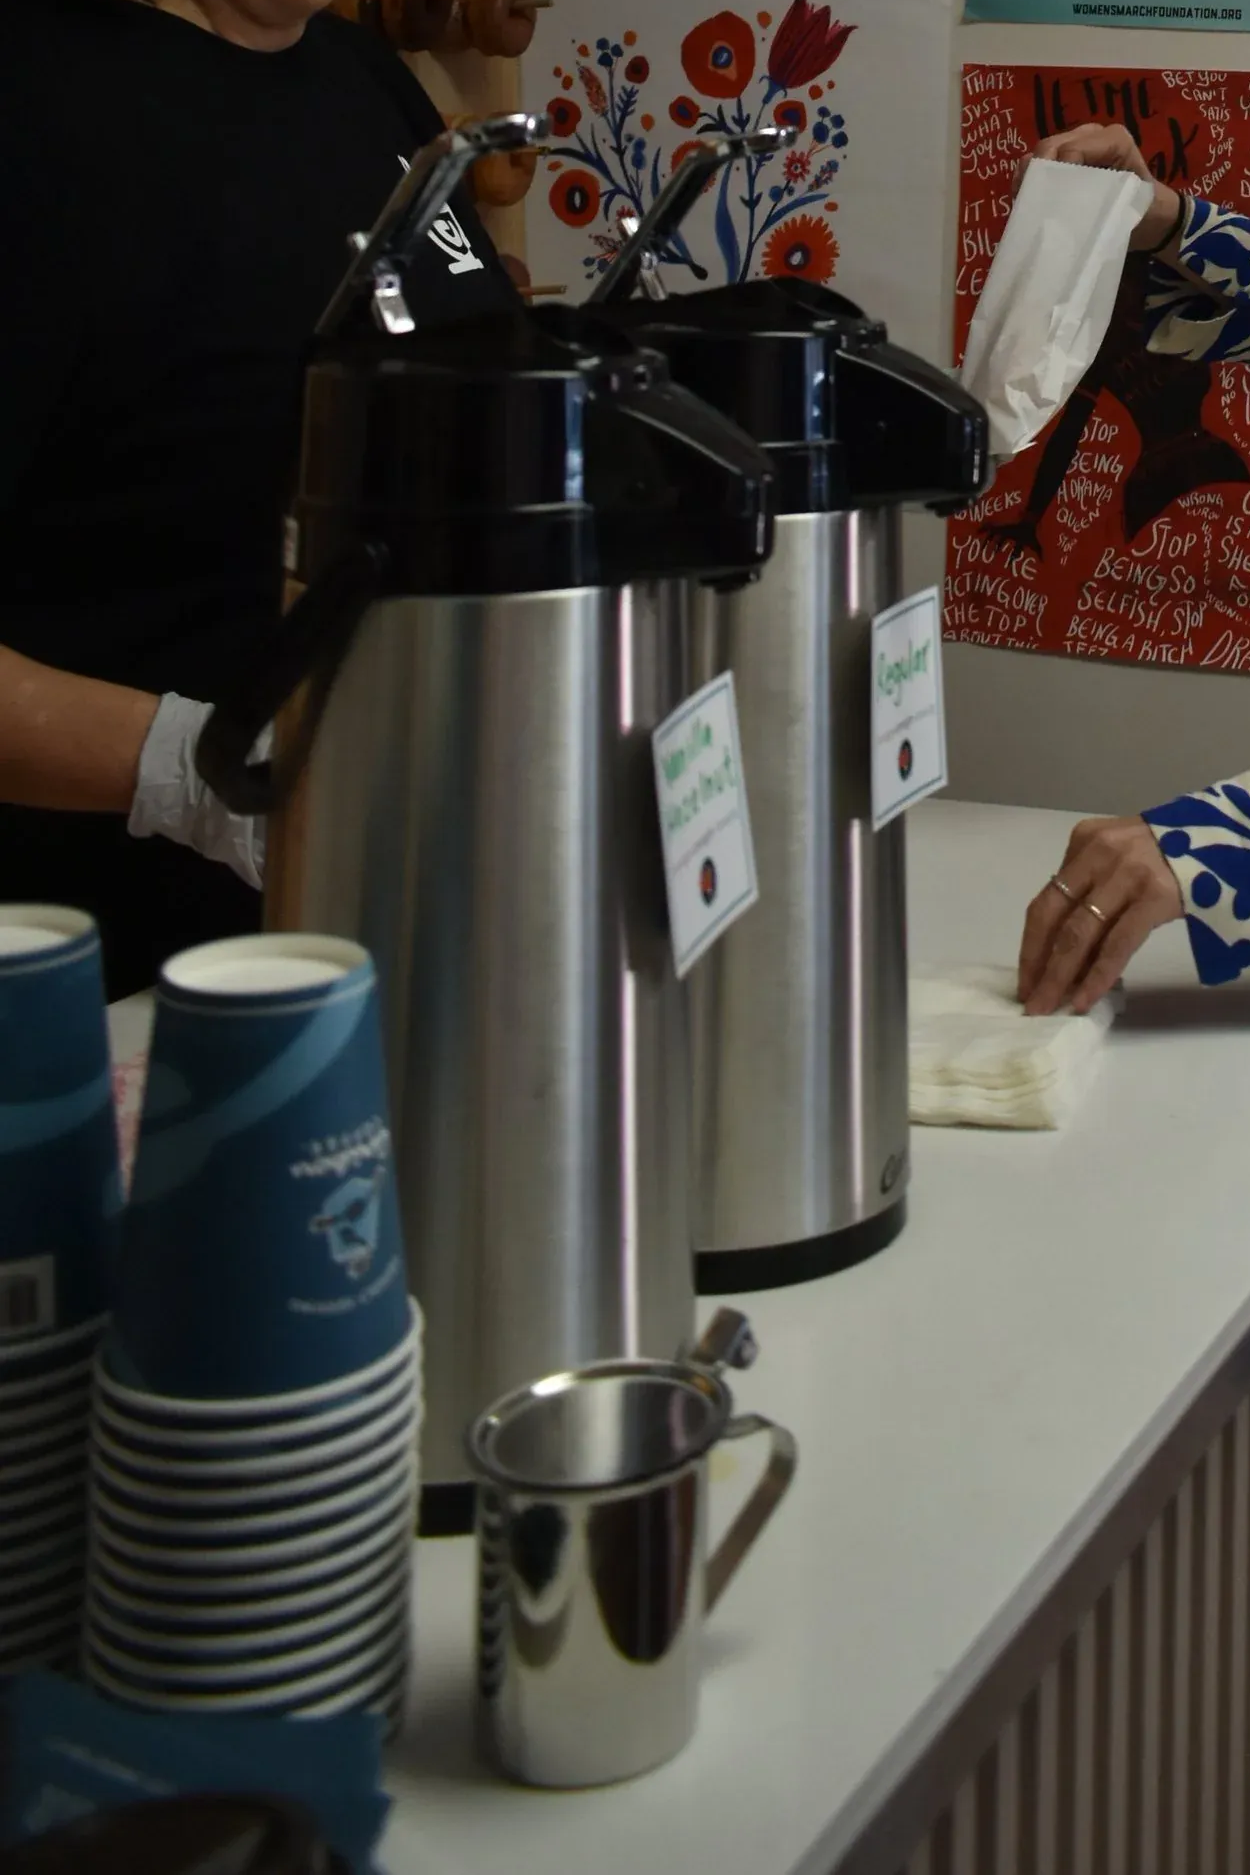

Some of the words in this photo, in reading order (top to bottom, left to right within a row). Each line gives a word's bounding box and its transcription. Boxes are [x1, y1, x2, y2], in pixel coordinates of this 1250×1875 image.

[1072, 4, 1242, 21] WOMENSMARCHFOUNDATION.ORG
[963, 69, 1014, 96] THAT'S
[1161, 71, 1194, 88] BET
[961, 108, 1014, 148] WHAT
[1131, 517, 1197, 560] STOP
[944, 571, 1010, 609] ACTING
[1093, 547, 1167, 606] BEING
[1169, 565, 1196, 594] SO
[1066, 614, 1119, 649] BEING
[1122, 633, 1136, 653] A
[1138, 637, 1193, 665] BITCH
